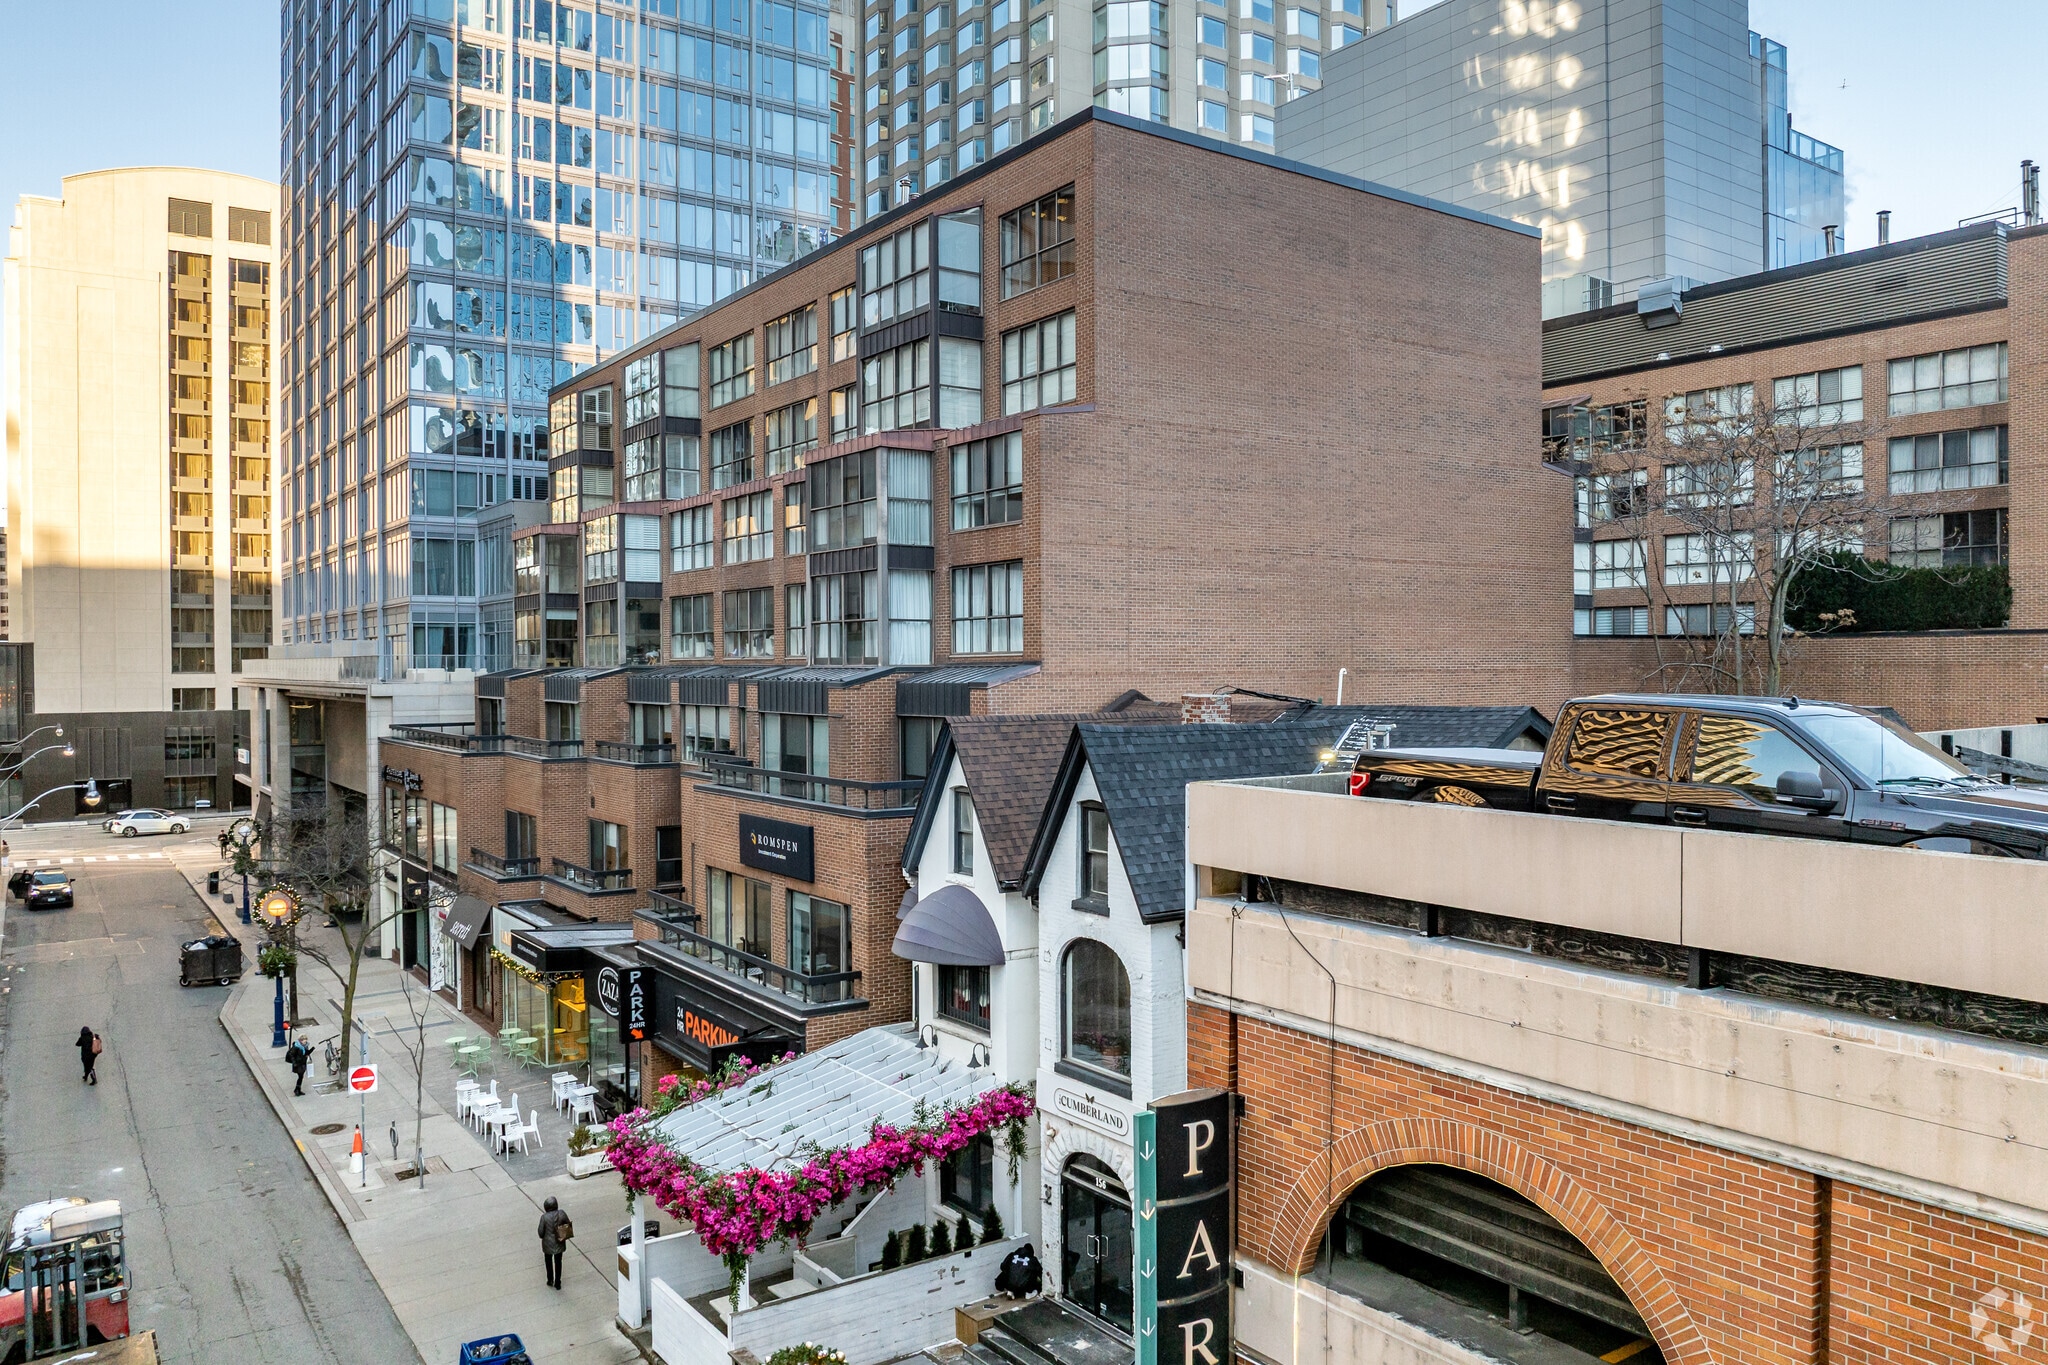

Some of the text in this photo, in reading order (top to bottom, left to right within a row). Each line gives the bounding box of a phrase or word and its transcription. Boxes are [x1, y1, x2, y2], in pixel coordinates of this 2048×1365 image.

[1374, 774, 1424, 783] SPORT
[757, 834, 798, 853] ROMSPEN
[629, 970, 644, 1022] PARK
[677, 1006, 684, 1020] 24
[629, 1021, 646, 1030] 24HR
[676, 1019, 685, 1034] HR
[1061, 1095, 1123, 1129] CUMBERLAND
[1095, 1177, 1107, 1190] 156
